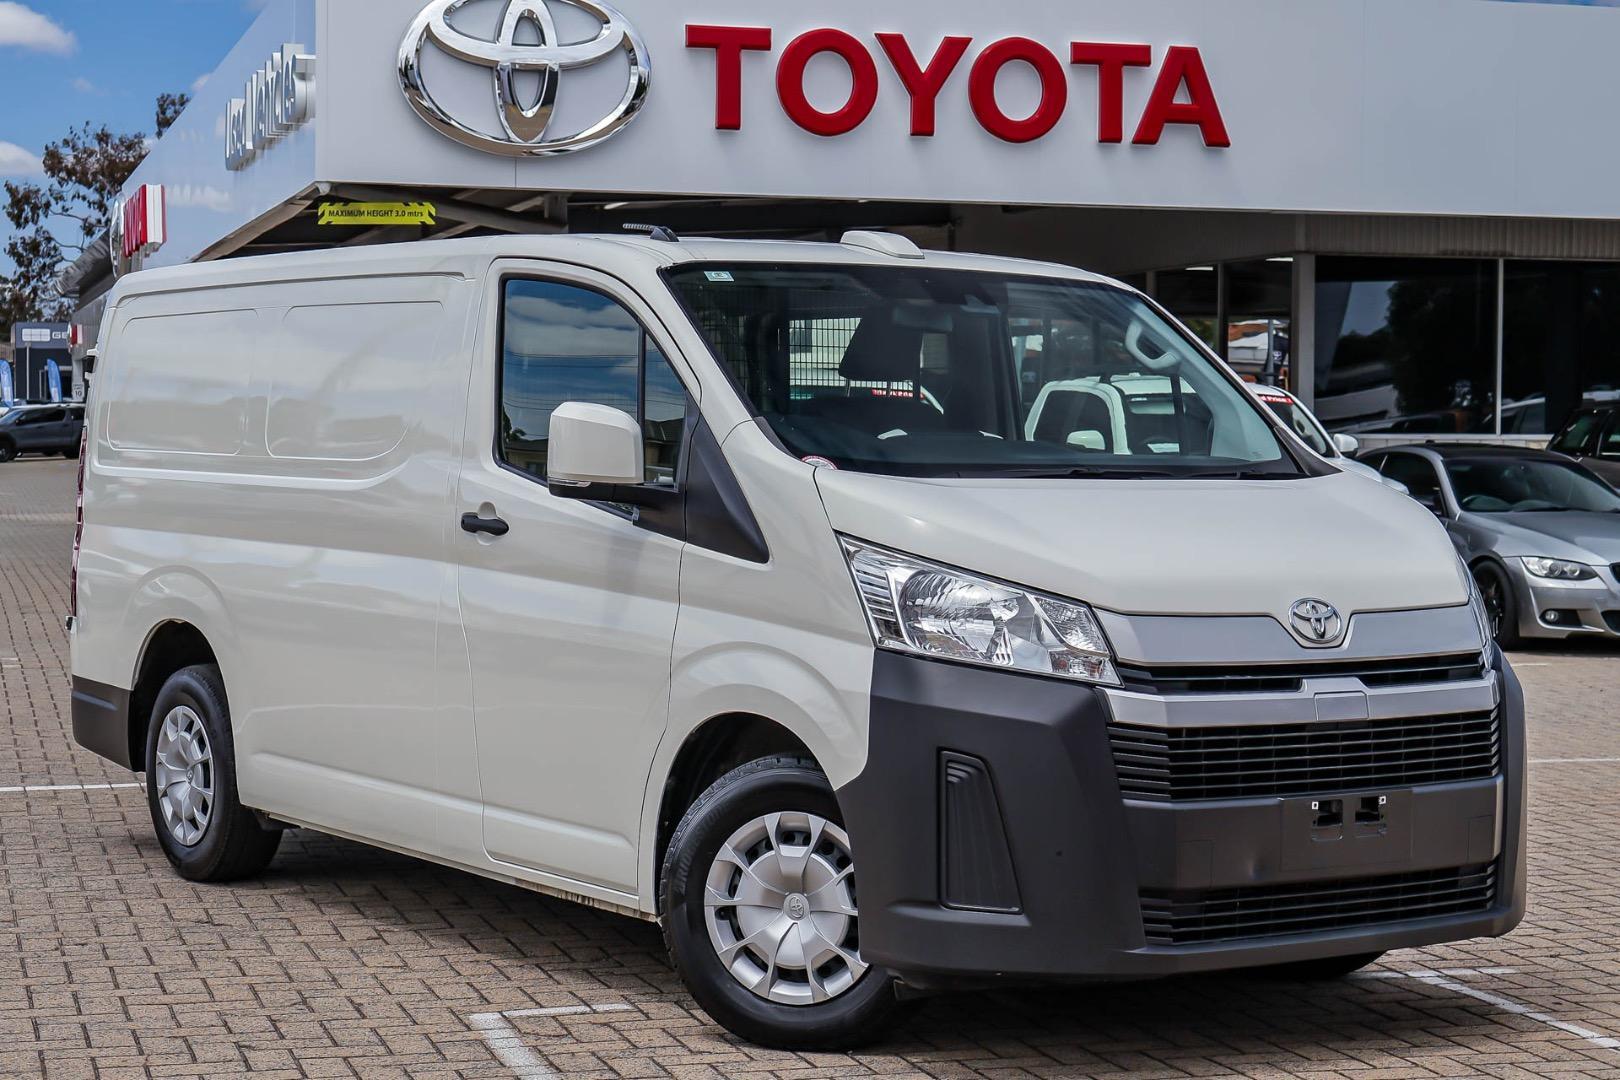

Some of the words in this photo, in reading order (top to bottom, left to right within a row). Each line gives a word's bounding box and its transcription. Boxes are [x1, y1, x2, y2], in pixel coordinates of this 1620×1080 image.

[685, 24, 1231, 148] TOYOTA
[328, 209, 366, 217] MAXIMUM
[366, 209, 394, 217] HEIGHT
[395, 209, 406, 217] 3.0
[407, 209, 424, 217] mtrs
